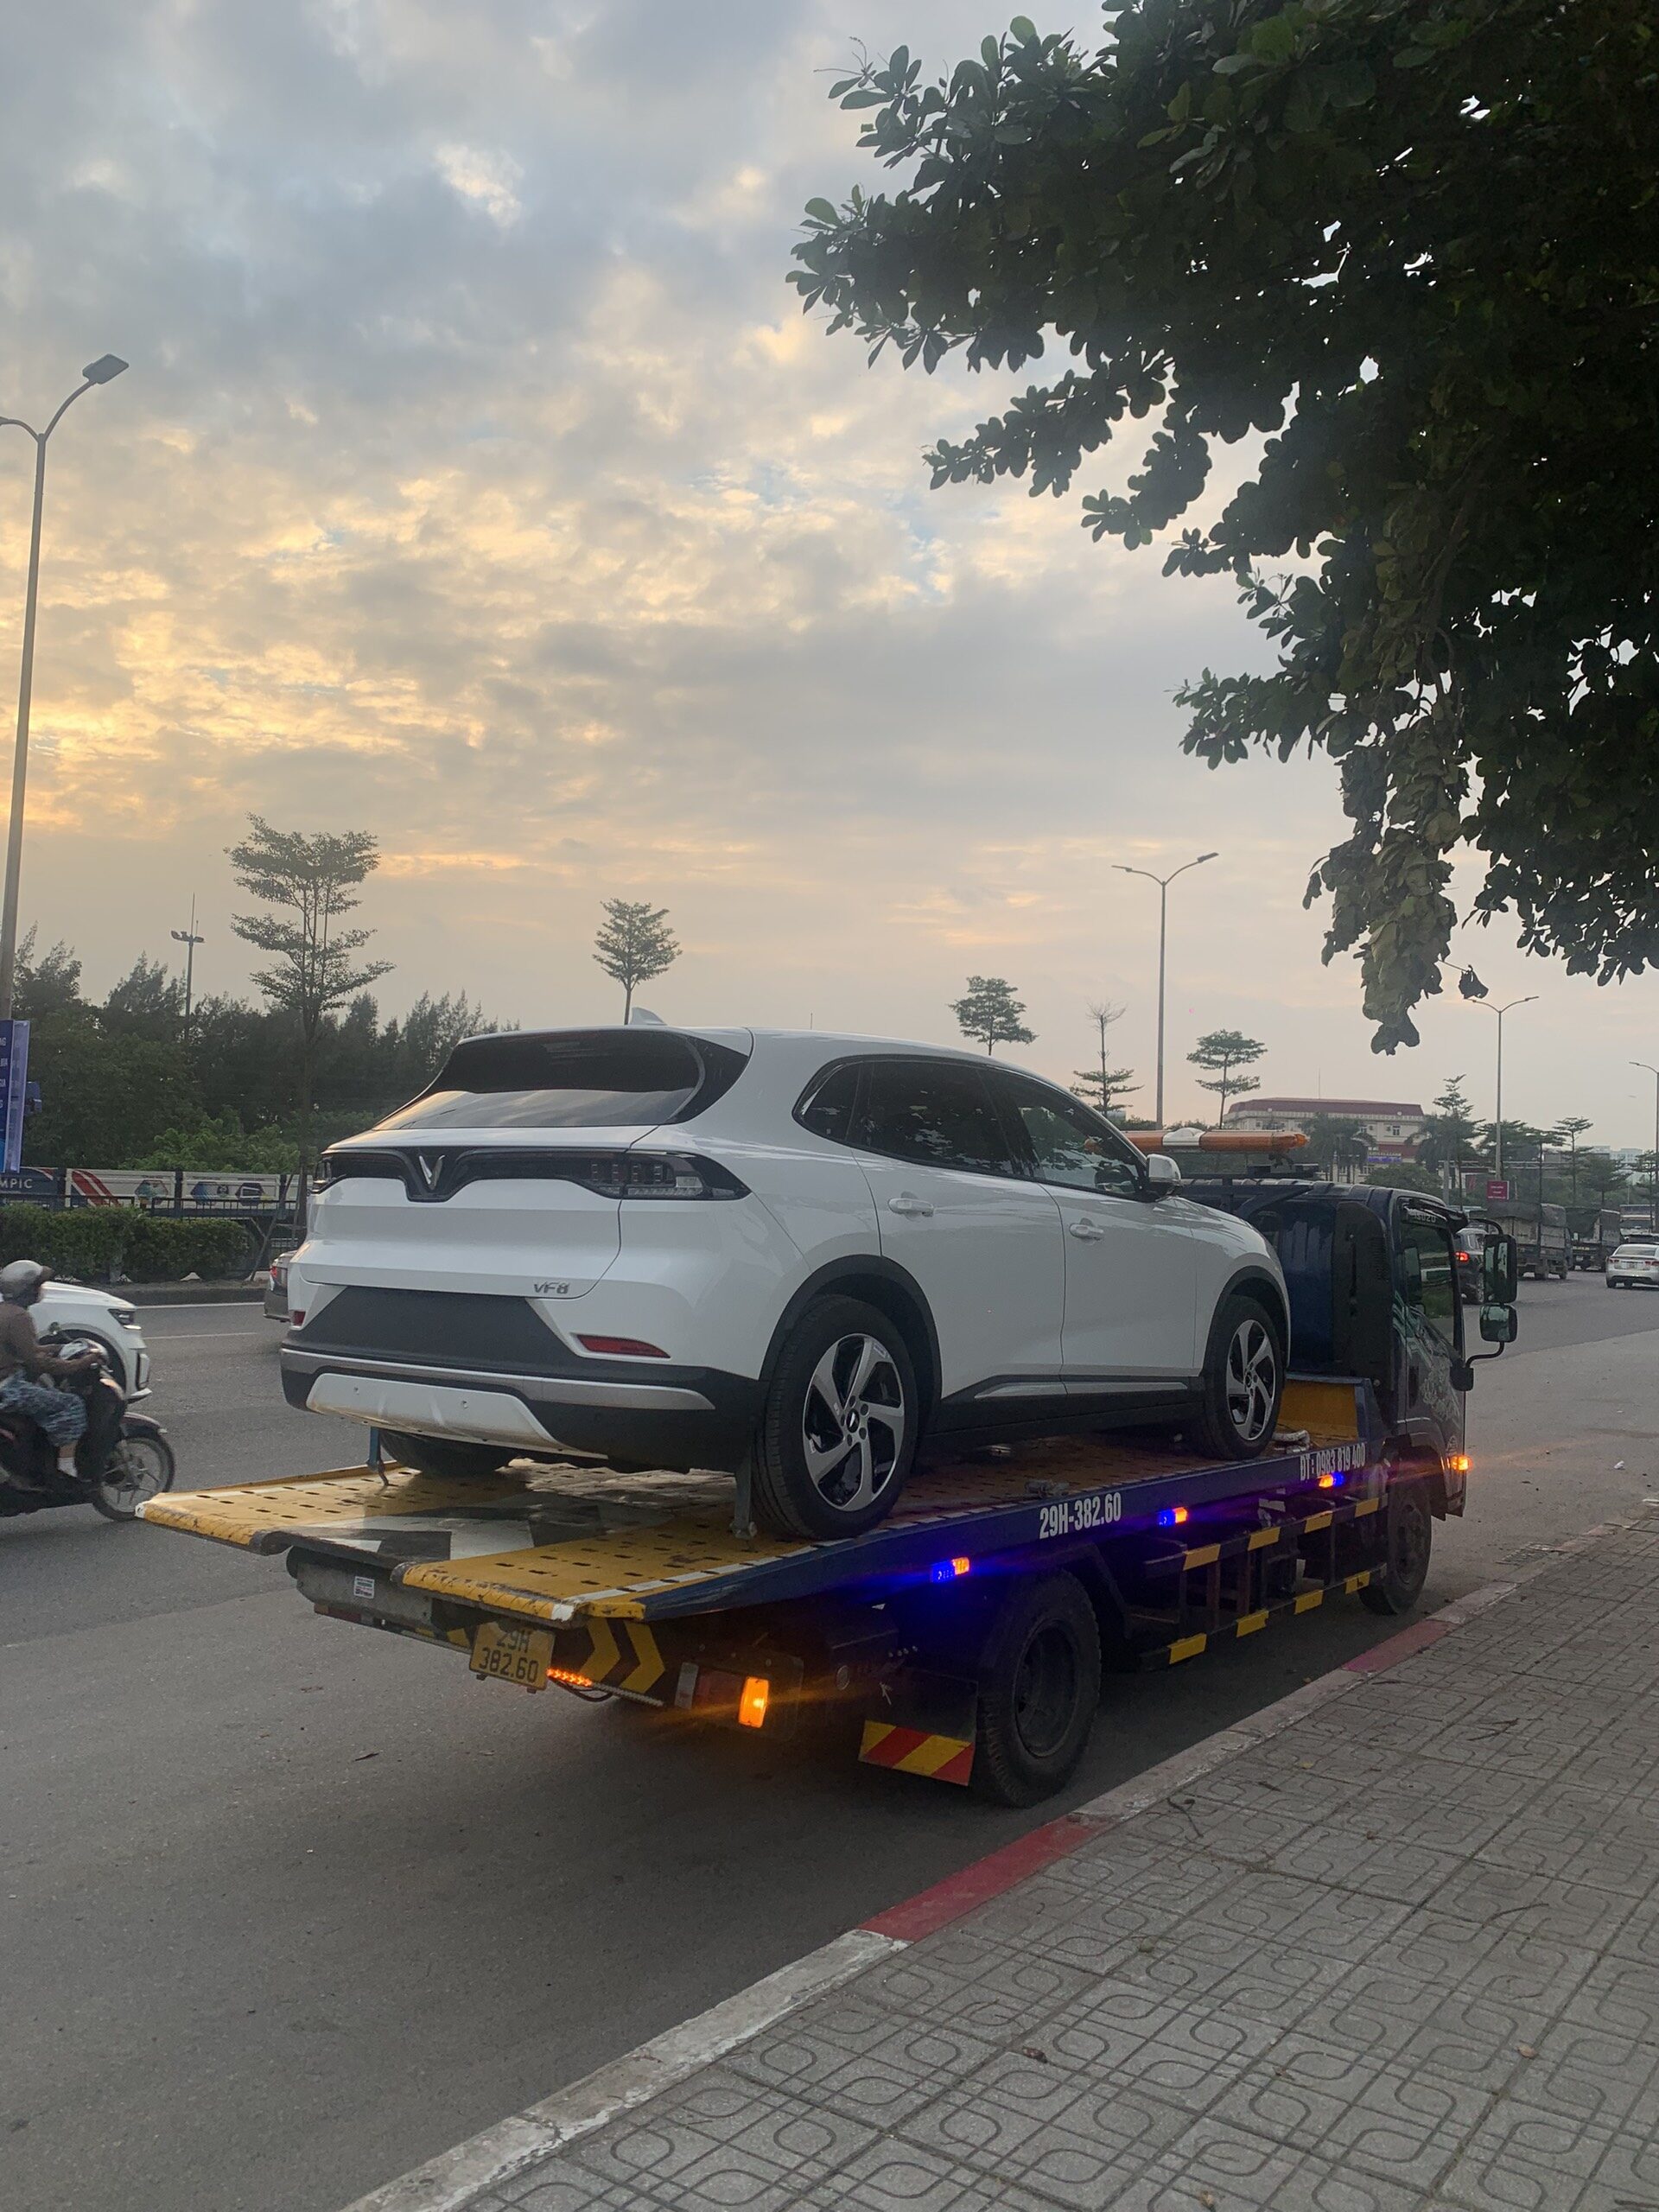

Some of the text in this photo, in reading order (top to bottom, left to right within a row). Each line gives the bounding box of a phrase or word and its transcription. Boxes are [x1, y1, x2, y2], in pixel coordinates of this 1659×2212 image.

[1316, 1451, 1335, 1476] 0983
[1338, 1447, 1351, 1472] 819
[1352, 1443, 1365, 1468] 400
[1039, 1492, 1122, 1539] 29H-382.60
[479, 1647, 538, 1683] 382.60
